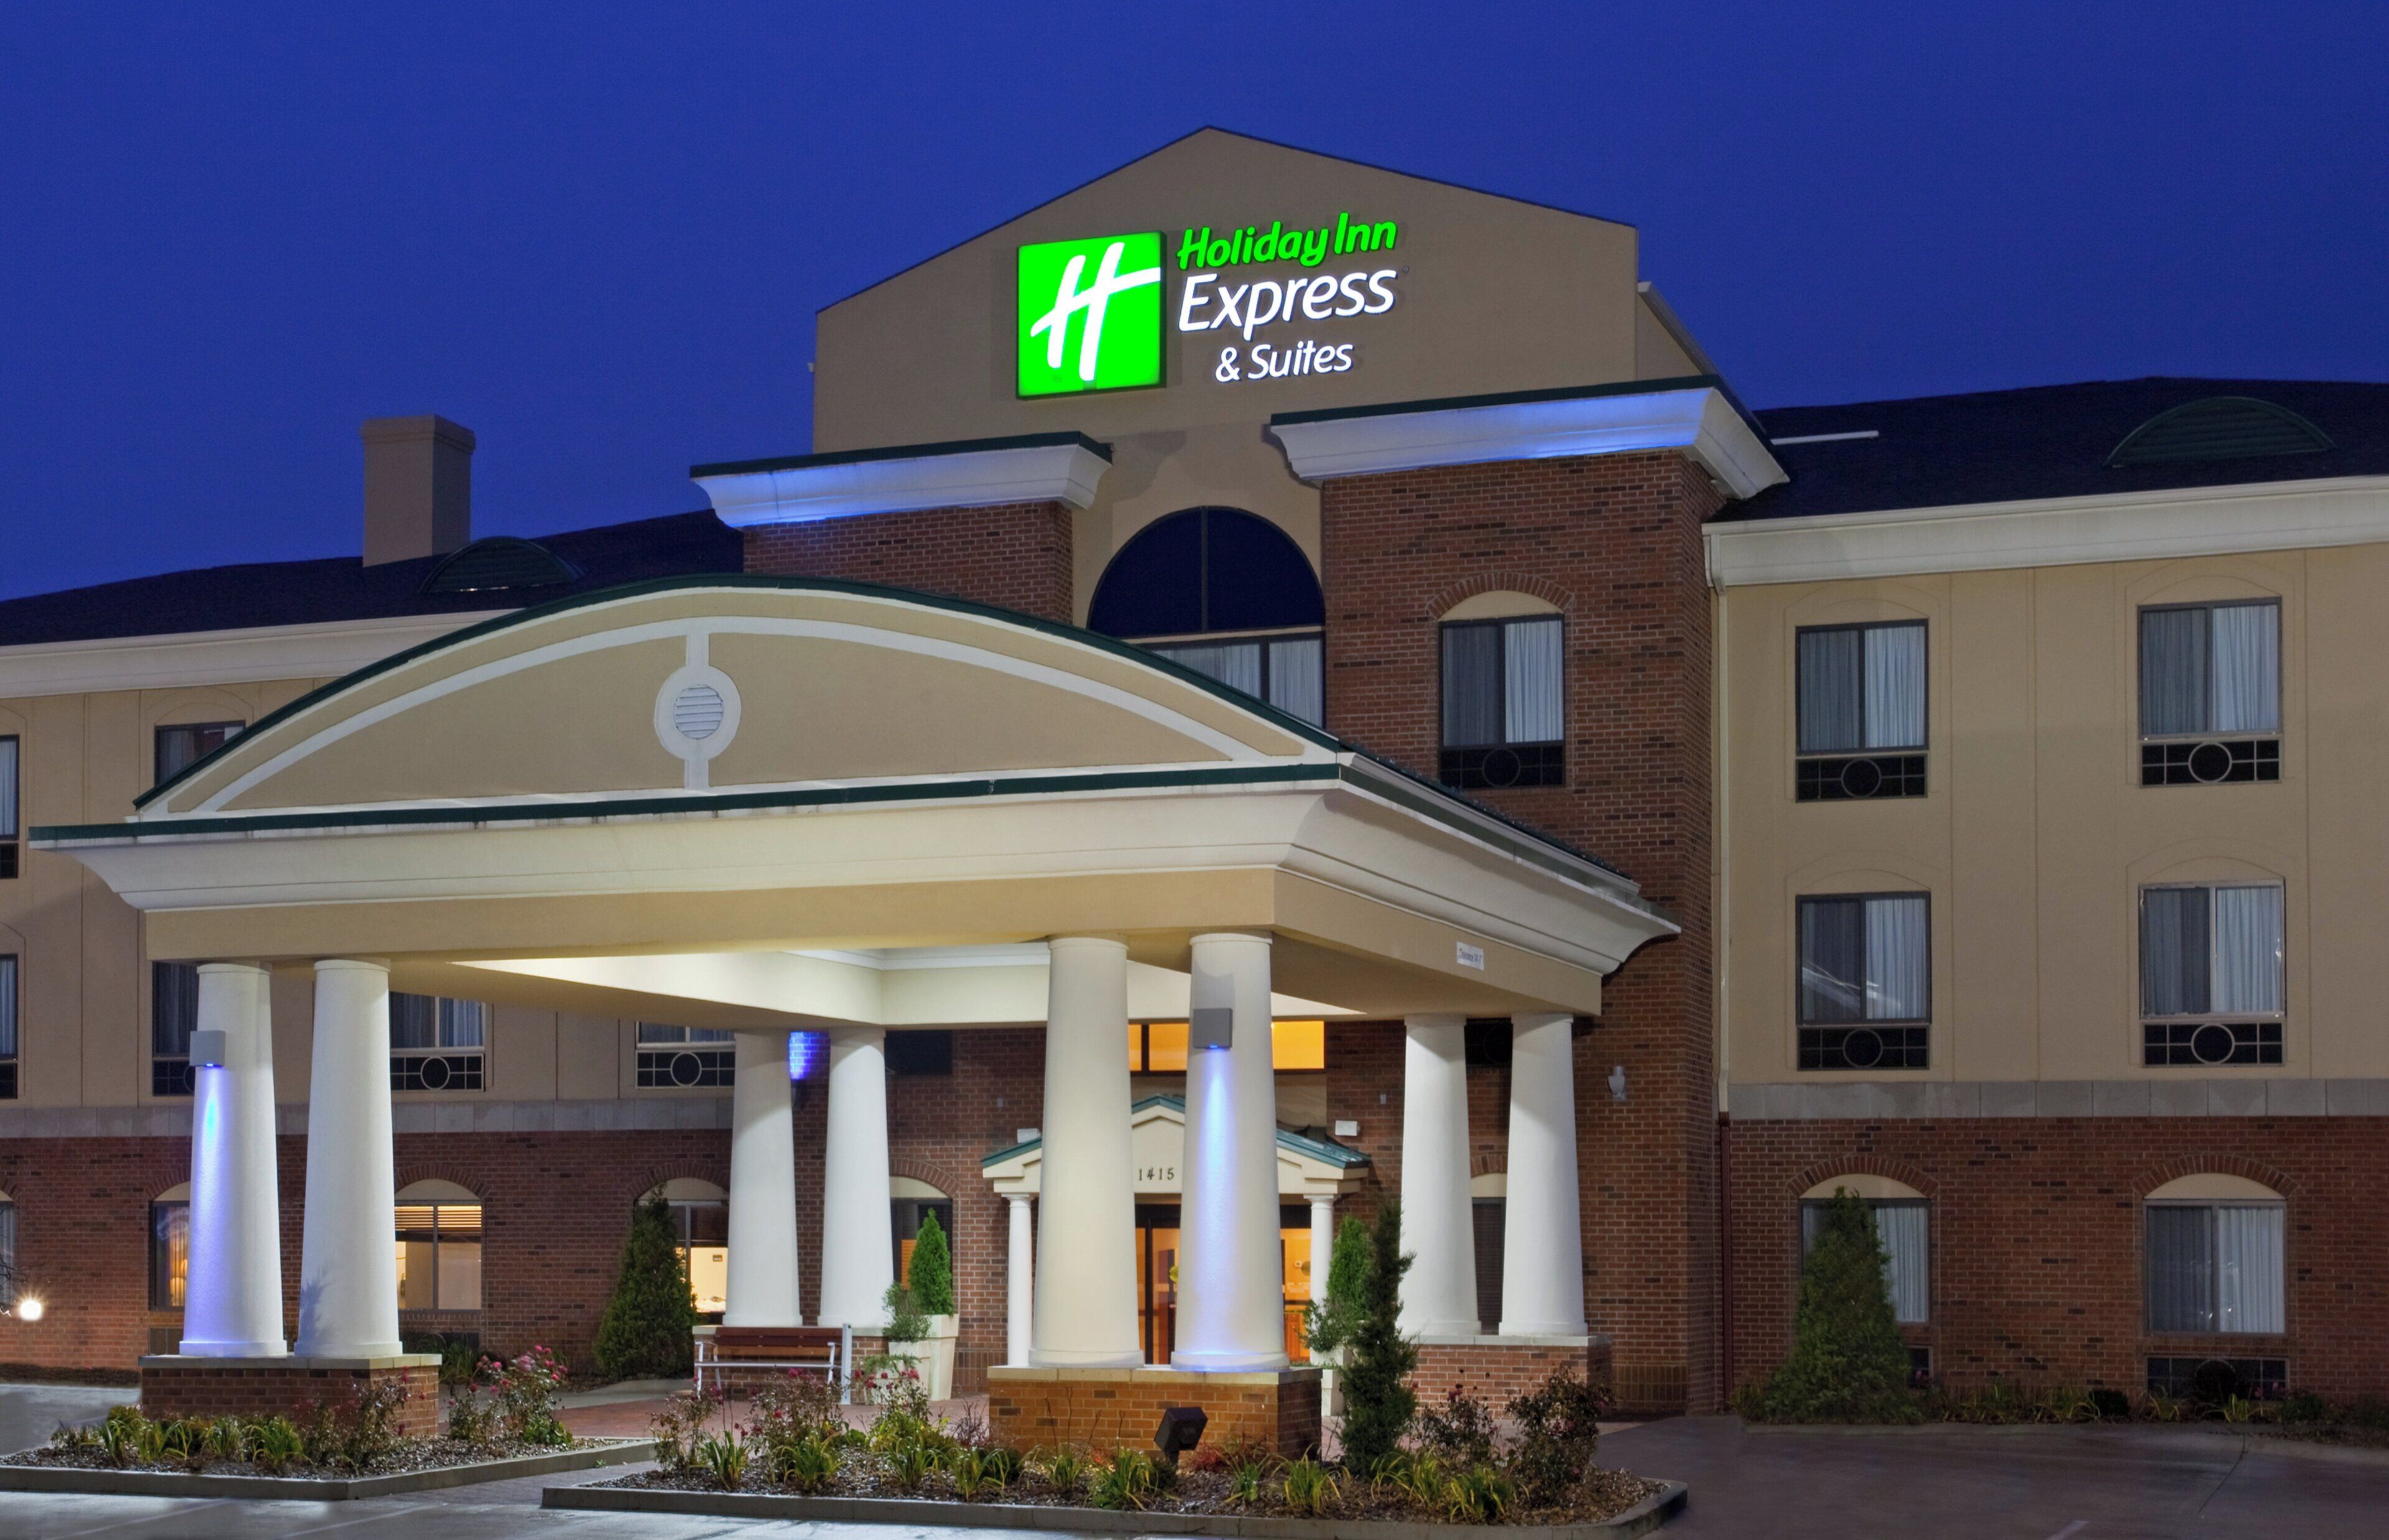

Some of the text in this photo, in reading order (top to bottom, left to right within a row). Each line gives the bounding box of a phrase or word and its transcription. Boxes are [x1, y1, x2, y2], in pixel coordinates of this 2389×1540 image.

[1176, 211, 1397, 270] Holiday Inn
[1178, 269, 1397, 341] Express
[1215, 339, 1354, 383] & Suites
[1139, 1167, 1175, 1181] 1415
